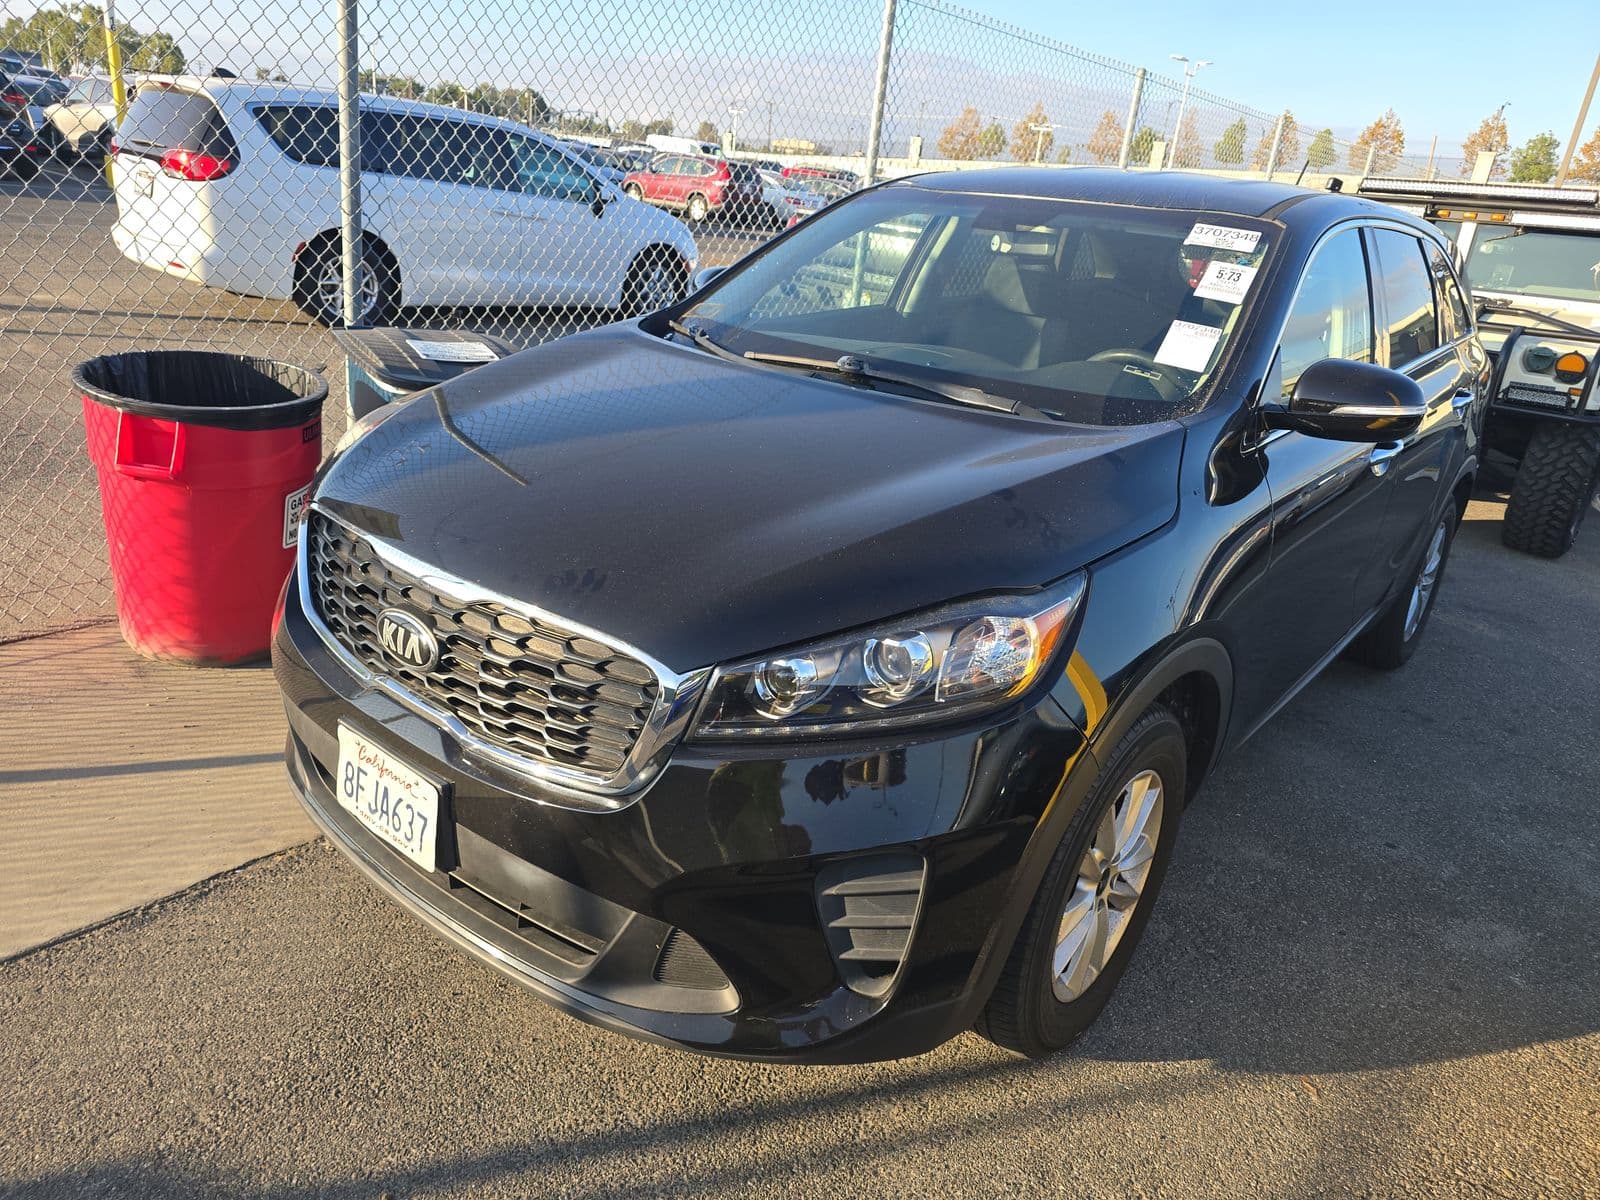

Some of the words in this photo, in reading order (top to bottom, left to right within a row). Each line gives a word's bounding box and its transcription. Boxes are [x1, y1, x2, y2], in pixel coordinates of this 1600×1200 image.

[1193, 226, 1260, 243] 3707348
[1216, 269, 1242, 283] 5:73
[382, 618, 423, 665] KIA
[358, 745, 415, 792] California
[344, 761, 428, 853] 8FJA637
